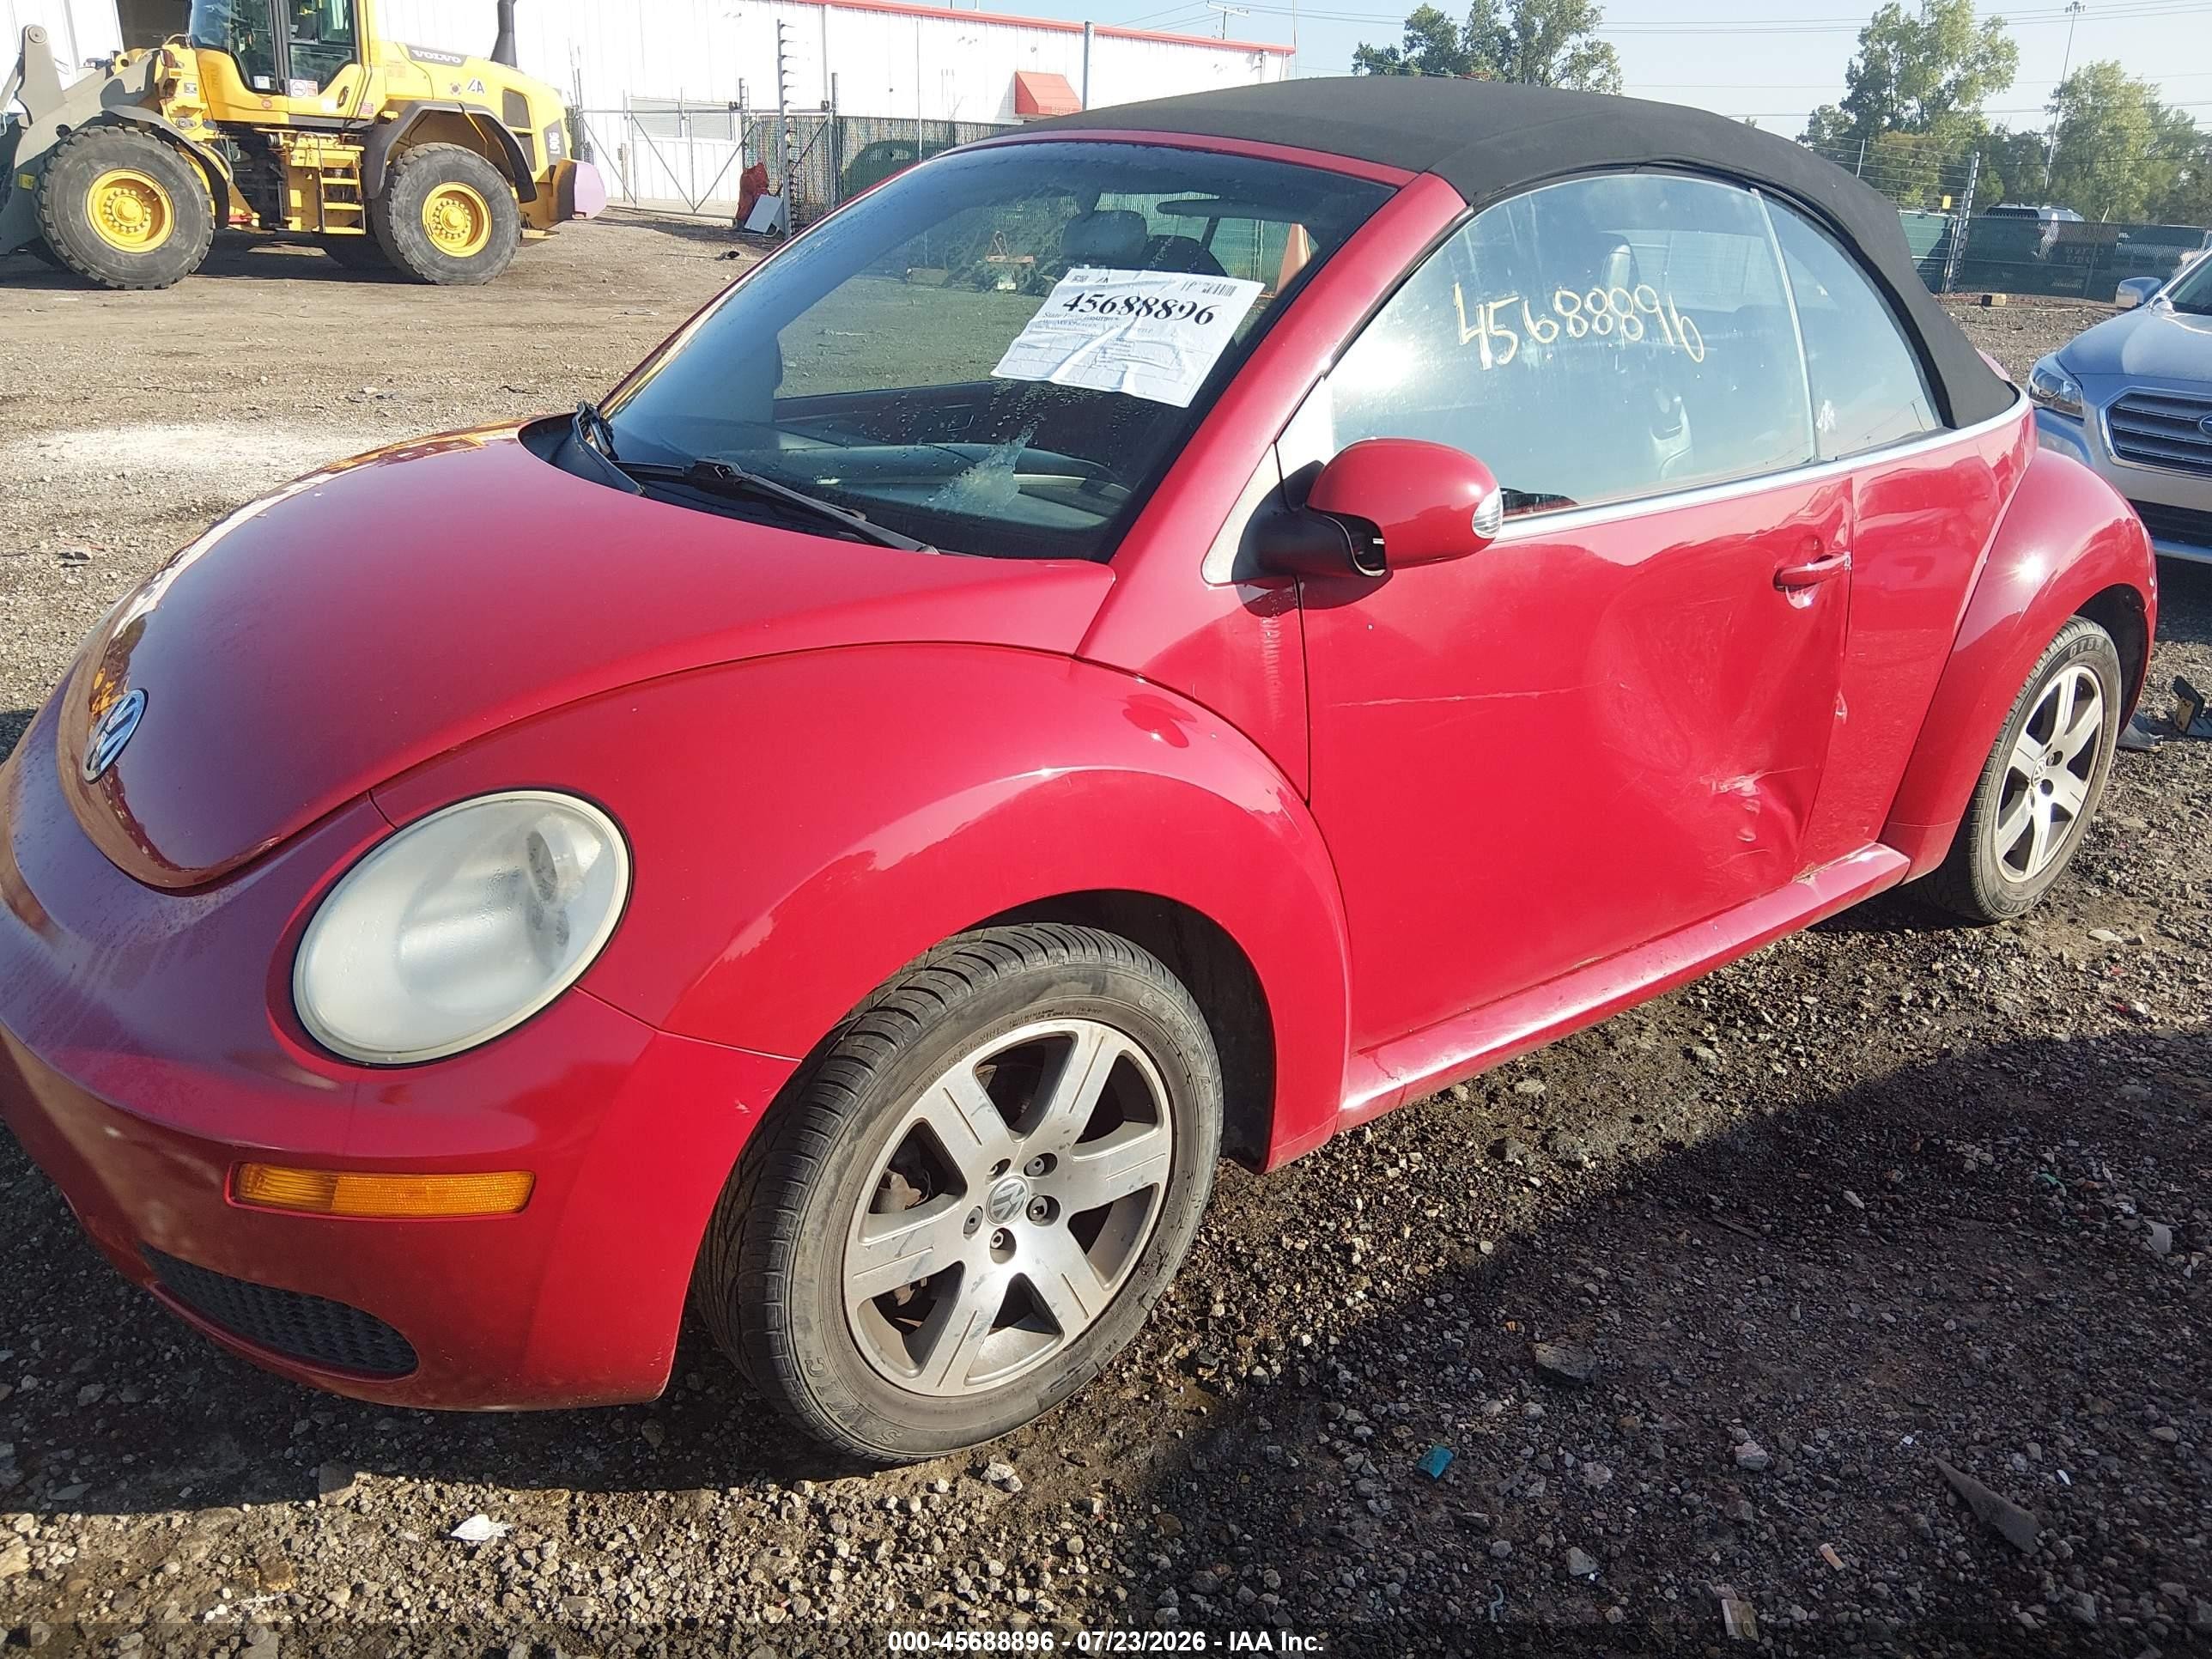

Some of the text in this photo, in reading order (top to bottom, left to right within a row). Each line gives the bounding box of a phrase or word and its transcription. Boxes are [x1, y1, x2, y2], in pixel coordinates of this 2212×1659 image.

[412, 49, 462, 64] VOLVO
[1063, 292, 1223, 325] 45688896
[1453, 282, 1705, 371] 45688896
